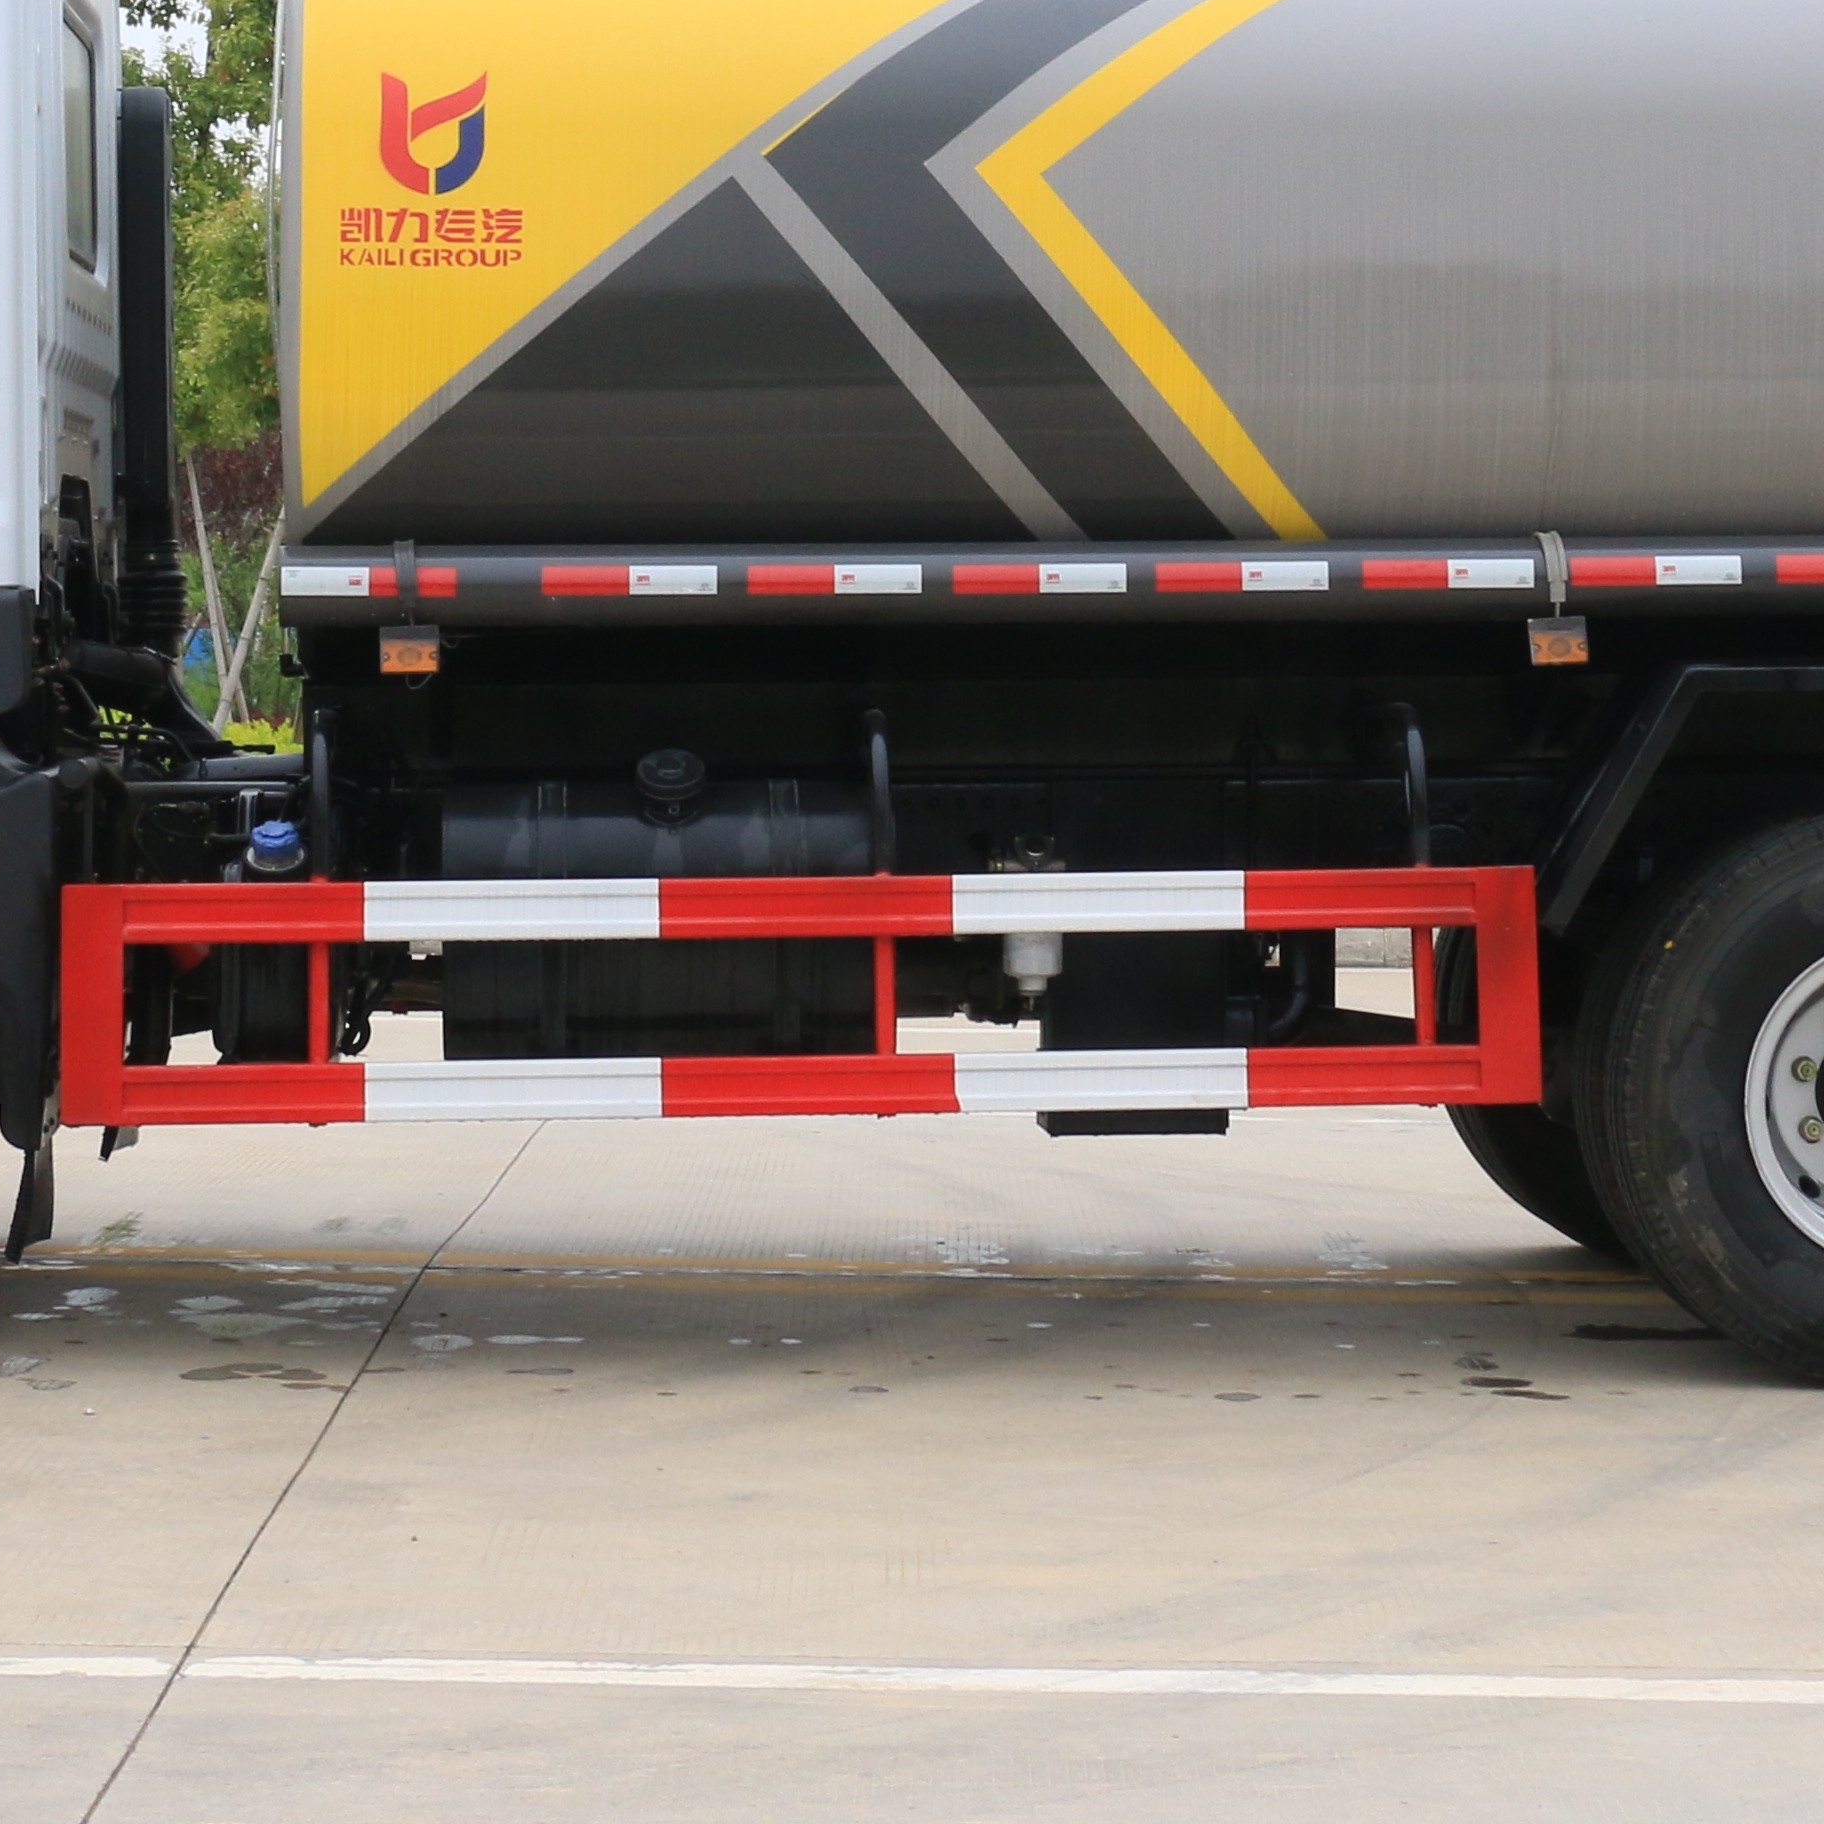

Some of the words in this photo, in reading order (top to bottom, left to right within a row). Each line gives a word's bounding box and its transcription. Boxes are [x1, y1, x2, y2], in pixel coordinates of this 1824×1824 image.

[339, 207, 524, 244] 凯力专汽
[339, 248, 405, 267] KAILI
[409, 248, 523, 268] GROUP
